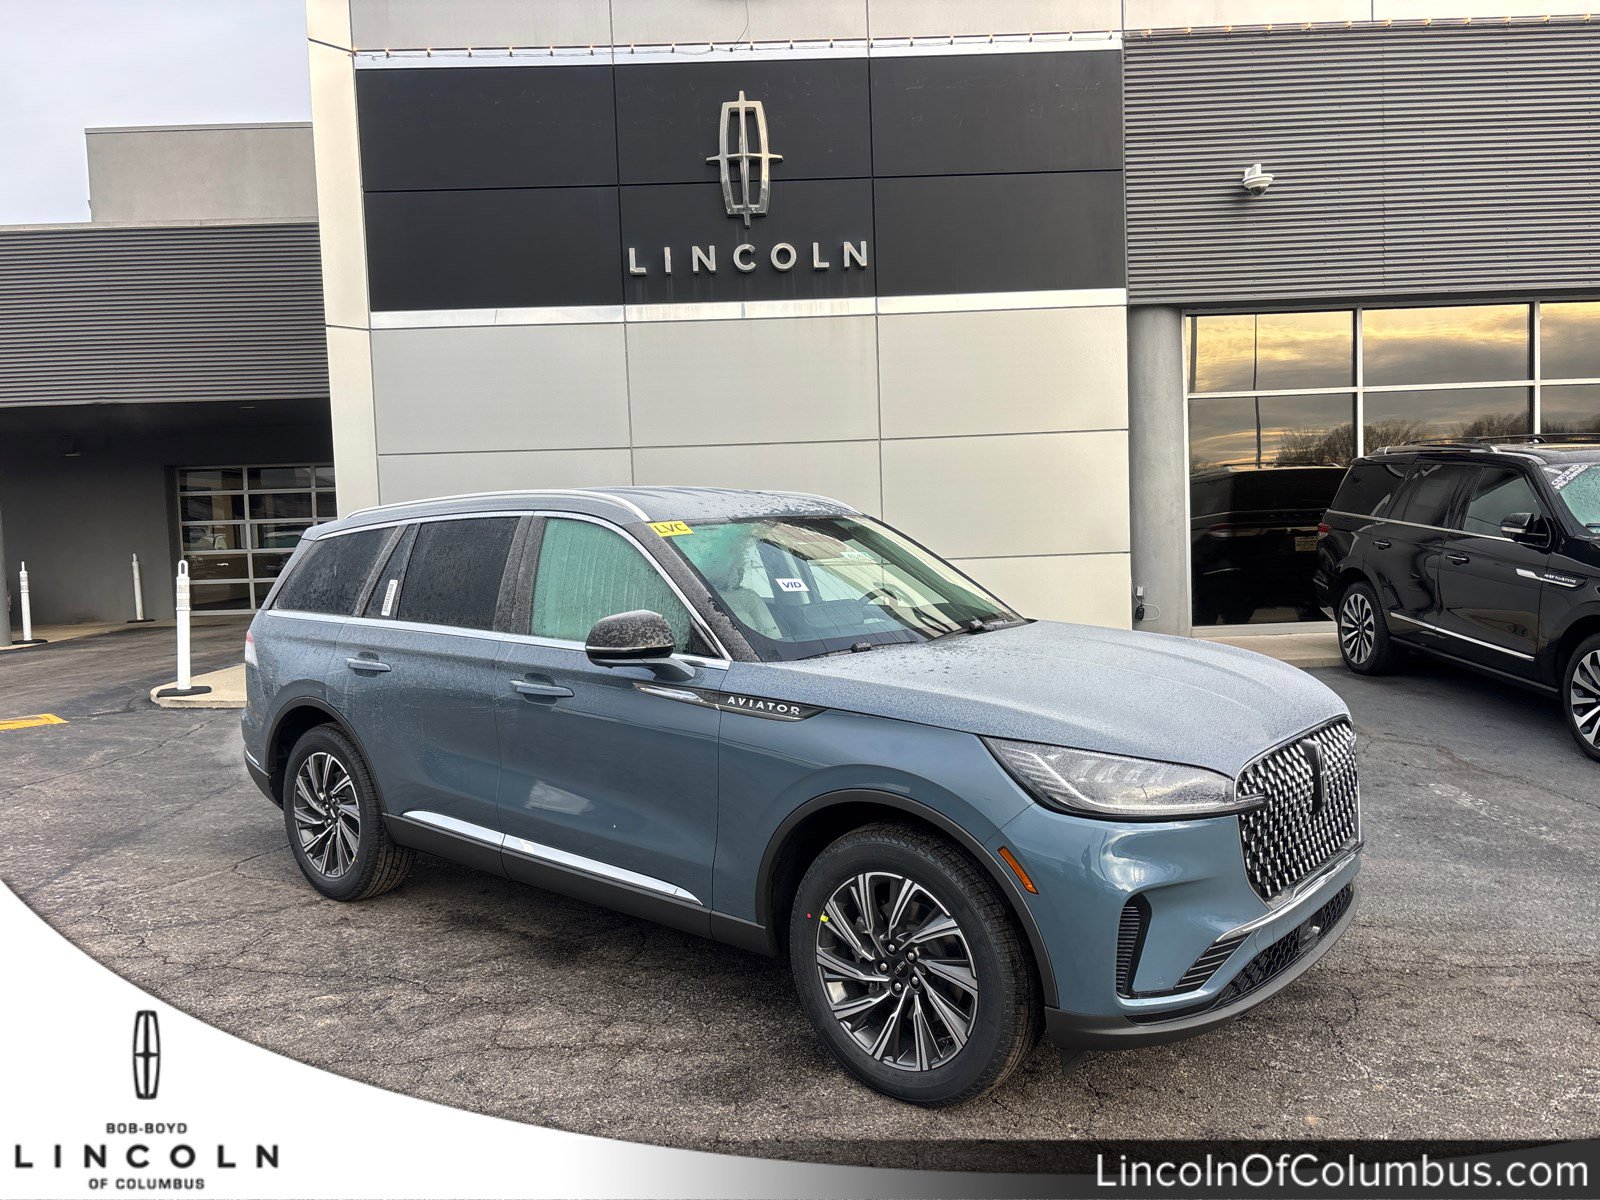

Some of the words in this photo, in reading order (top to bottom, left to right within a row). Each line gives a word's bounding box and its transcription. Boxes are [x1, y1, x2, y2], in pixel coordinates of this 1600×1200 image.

[628, 240, 868, 276] LINCOLN
[653, 523, 688, 534] LVC
[781, 580, 803, 589] VID
[726, 696, 800, 716] AVIATOR
